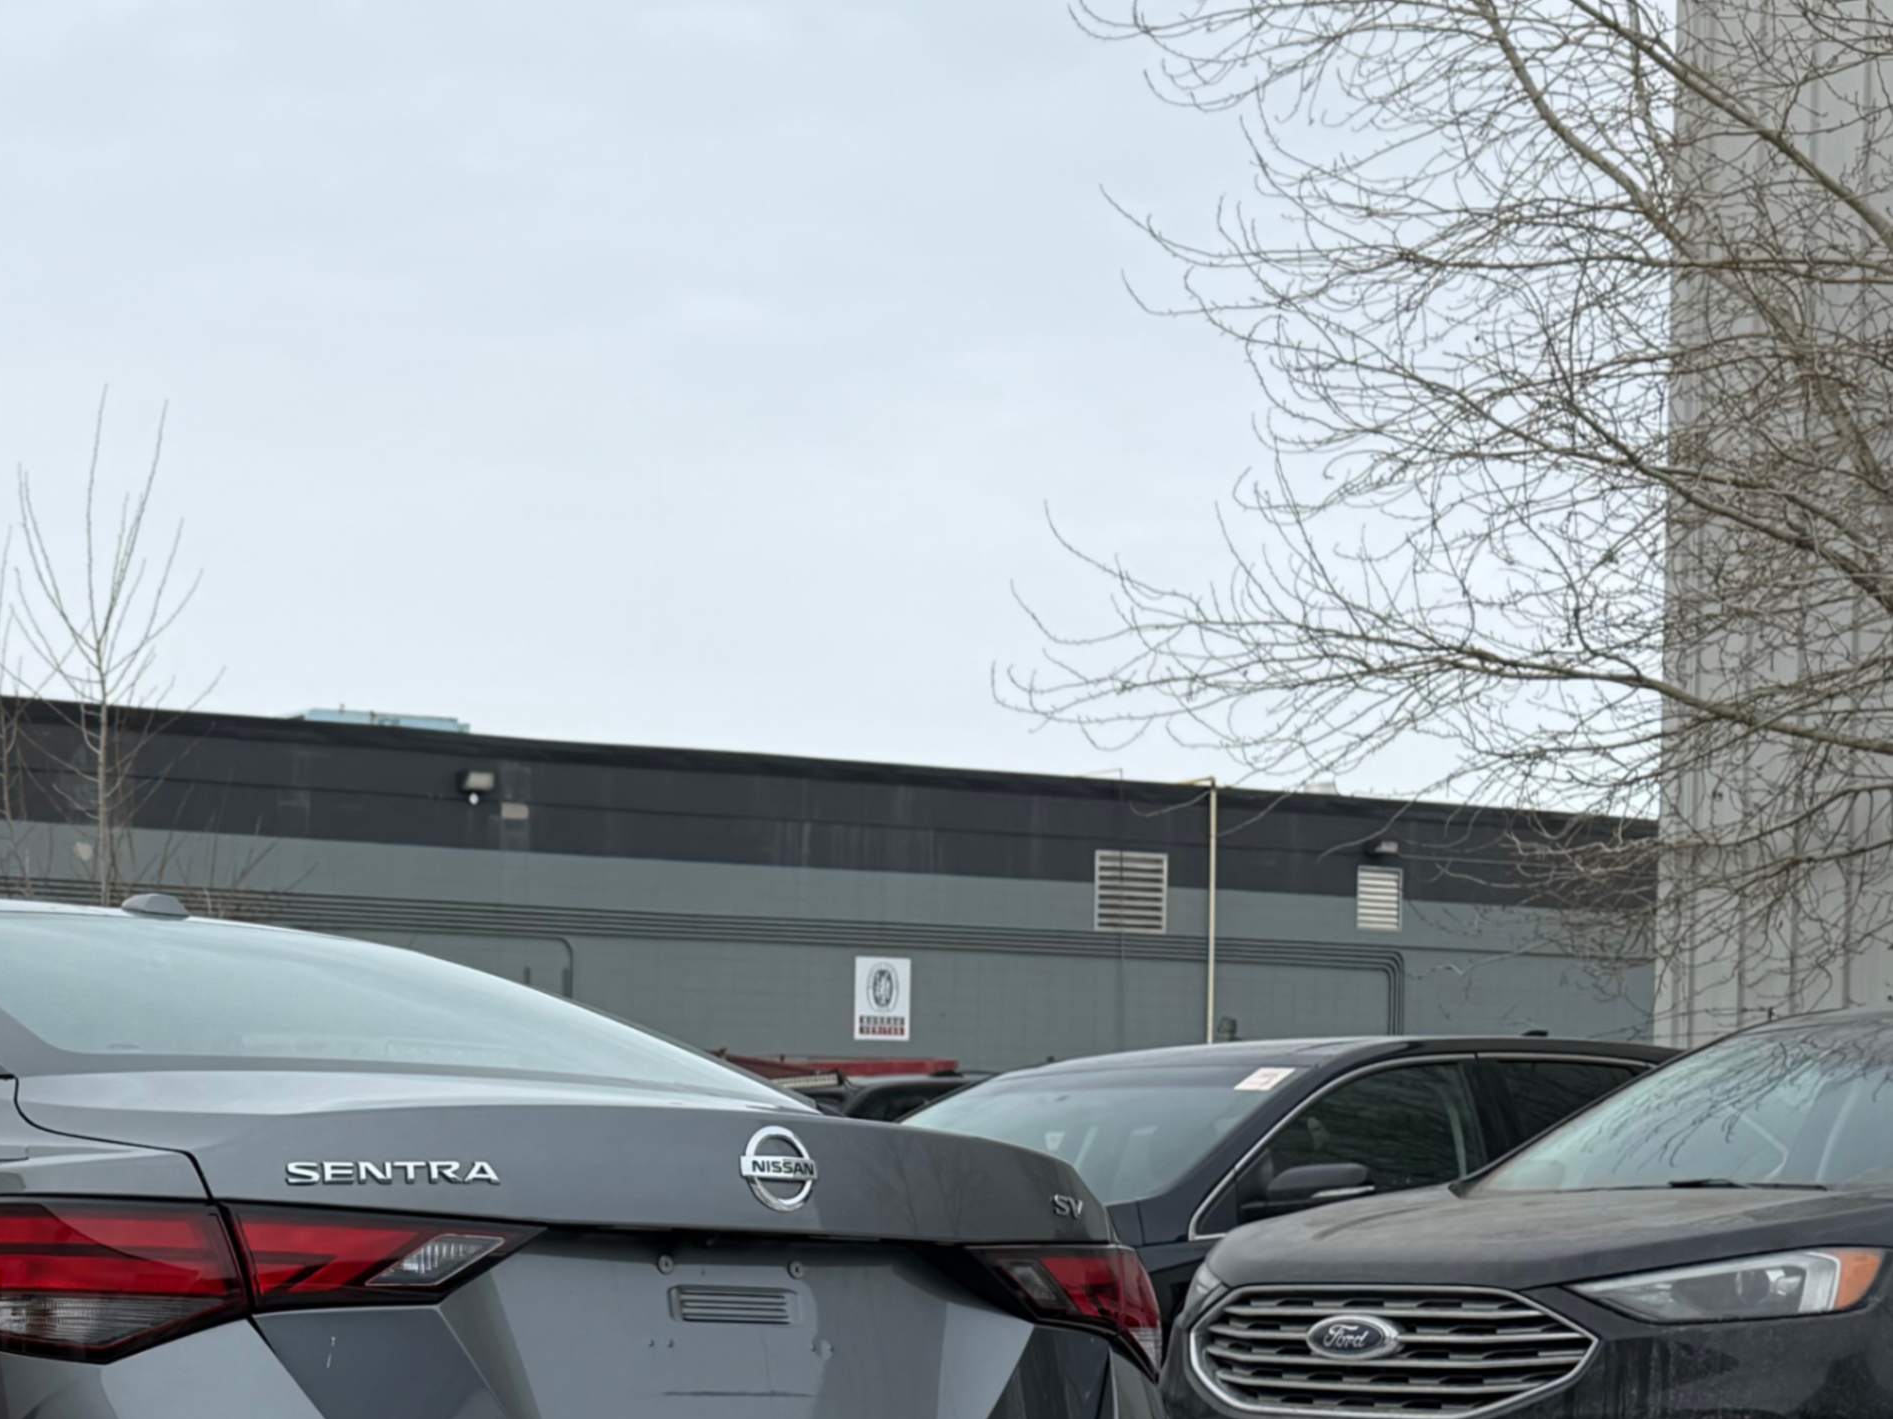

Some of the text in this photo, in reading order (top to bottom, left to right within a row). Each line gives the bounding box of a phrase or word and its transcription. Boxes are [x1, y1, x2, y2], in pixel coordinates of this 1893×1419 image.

[286, 1160, 501, 1185] SENTRA
[752, 1160, 814, 1175] NISSAN
[1053, 1193, 1083, 1220] SV
[1324, 1324, 1369, 1347] Ford
